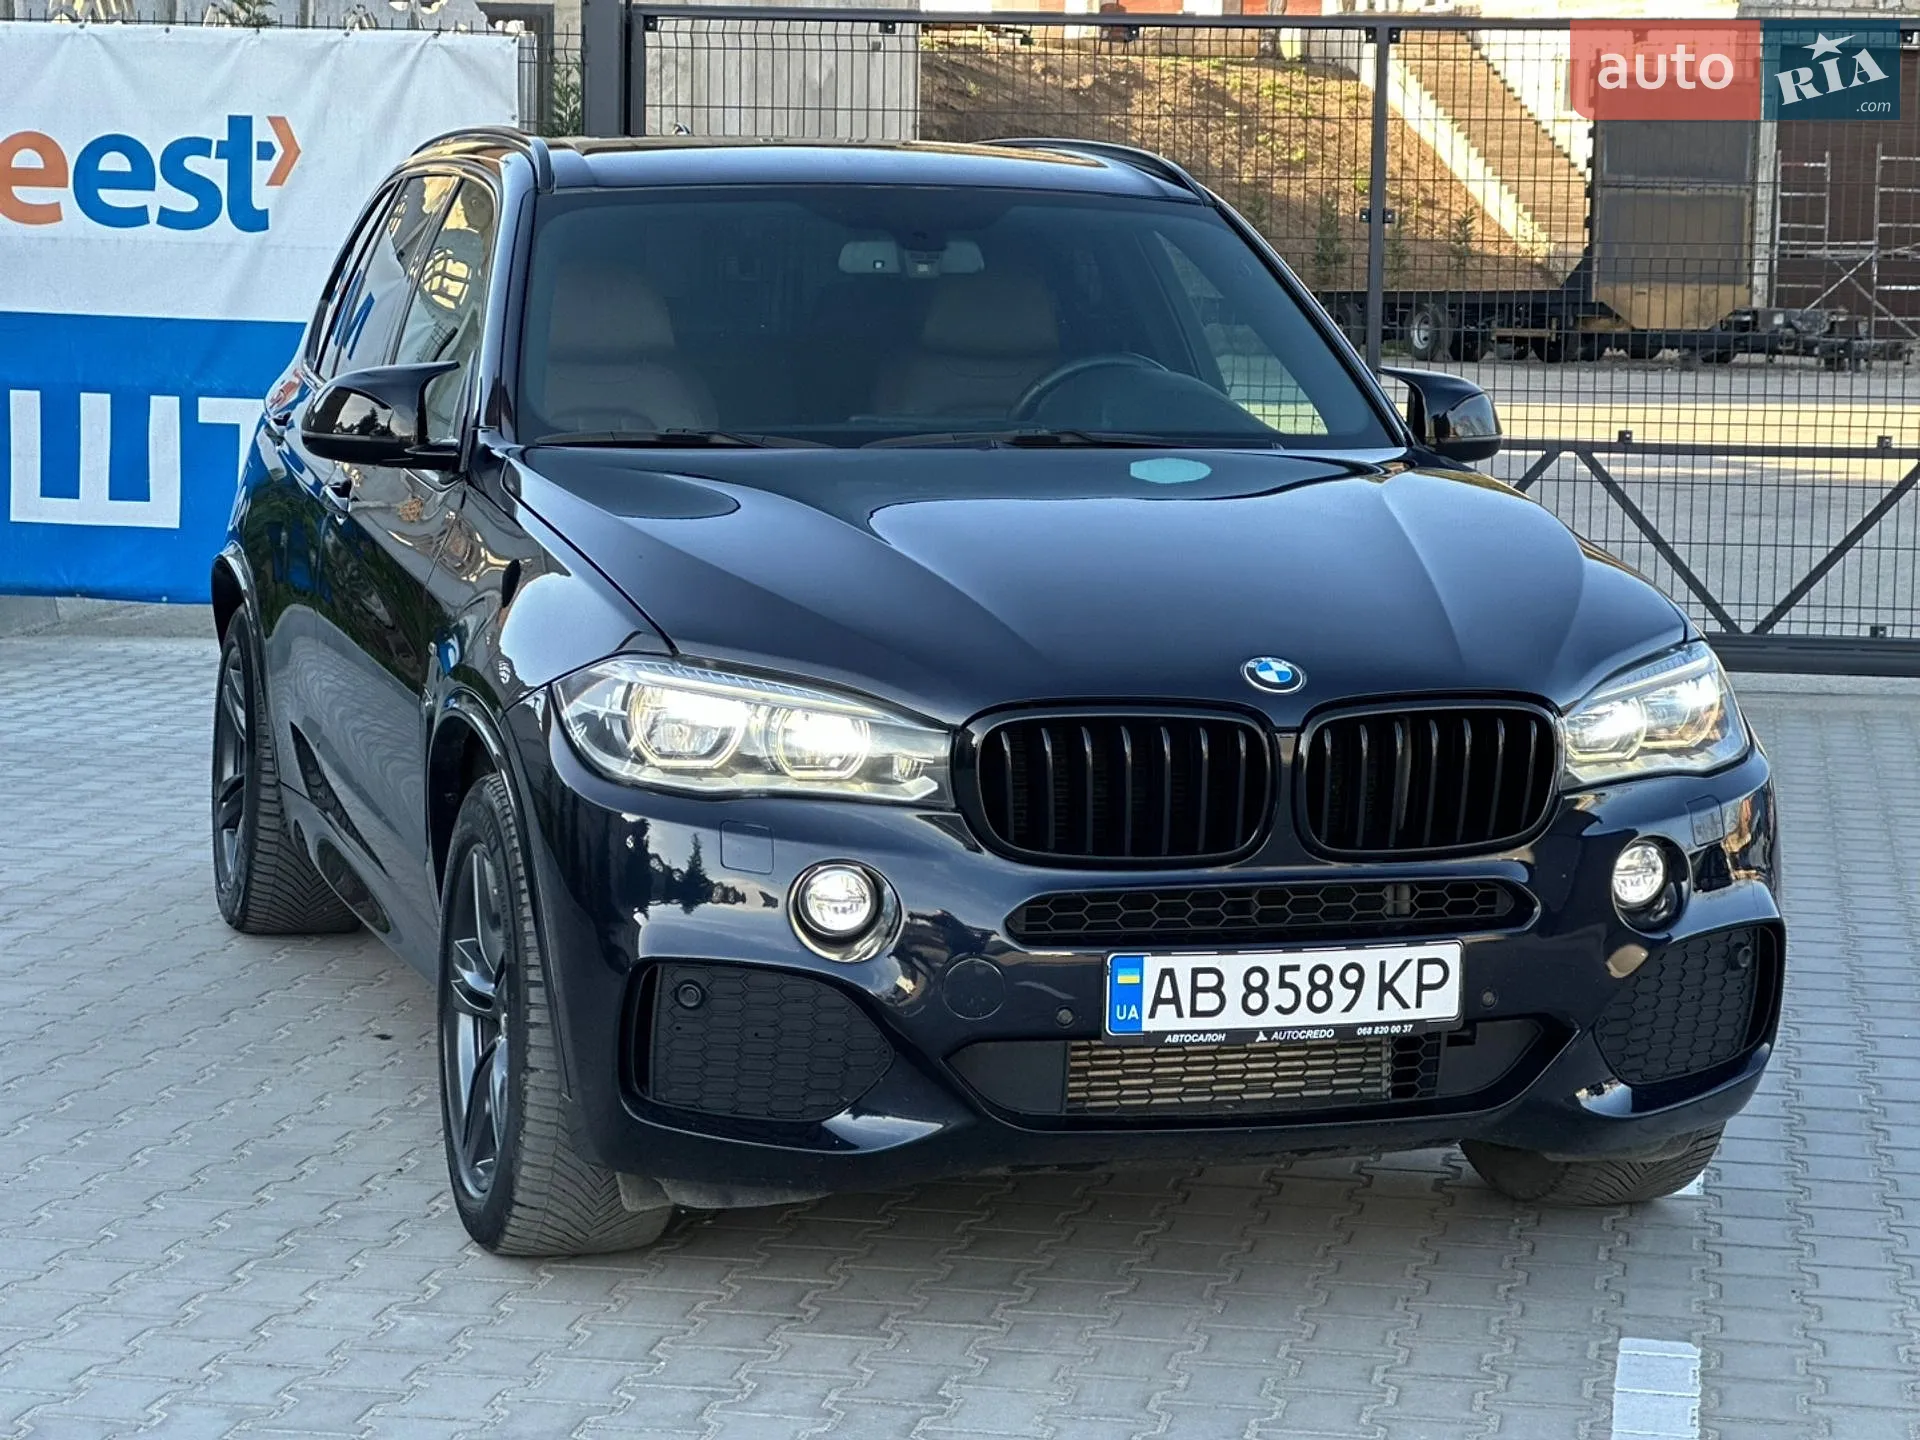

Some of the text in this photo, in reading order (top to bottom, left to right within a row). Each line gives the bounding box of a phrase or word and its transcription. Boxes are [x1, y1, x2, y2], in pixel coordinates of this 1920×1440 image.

[1148, 957, 1450, 1019] AB 8589 KP
[1116, 1004, 1140, 1021] UA
[1270, 1028, 1335, 1041] AUTOCREDO
[1402, 1023, 1414, 1033] 37
[1165, 1033, 1226, 1043] АВТОСАЛОН
